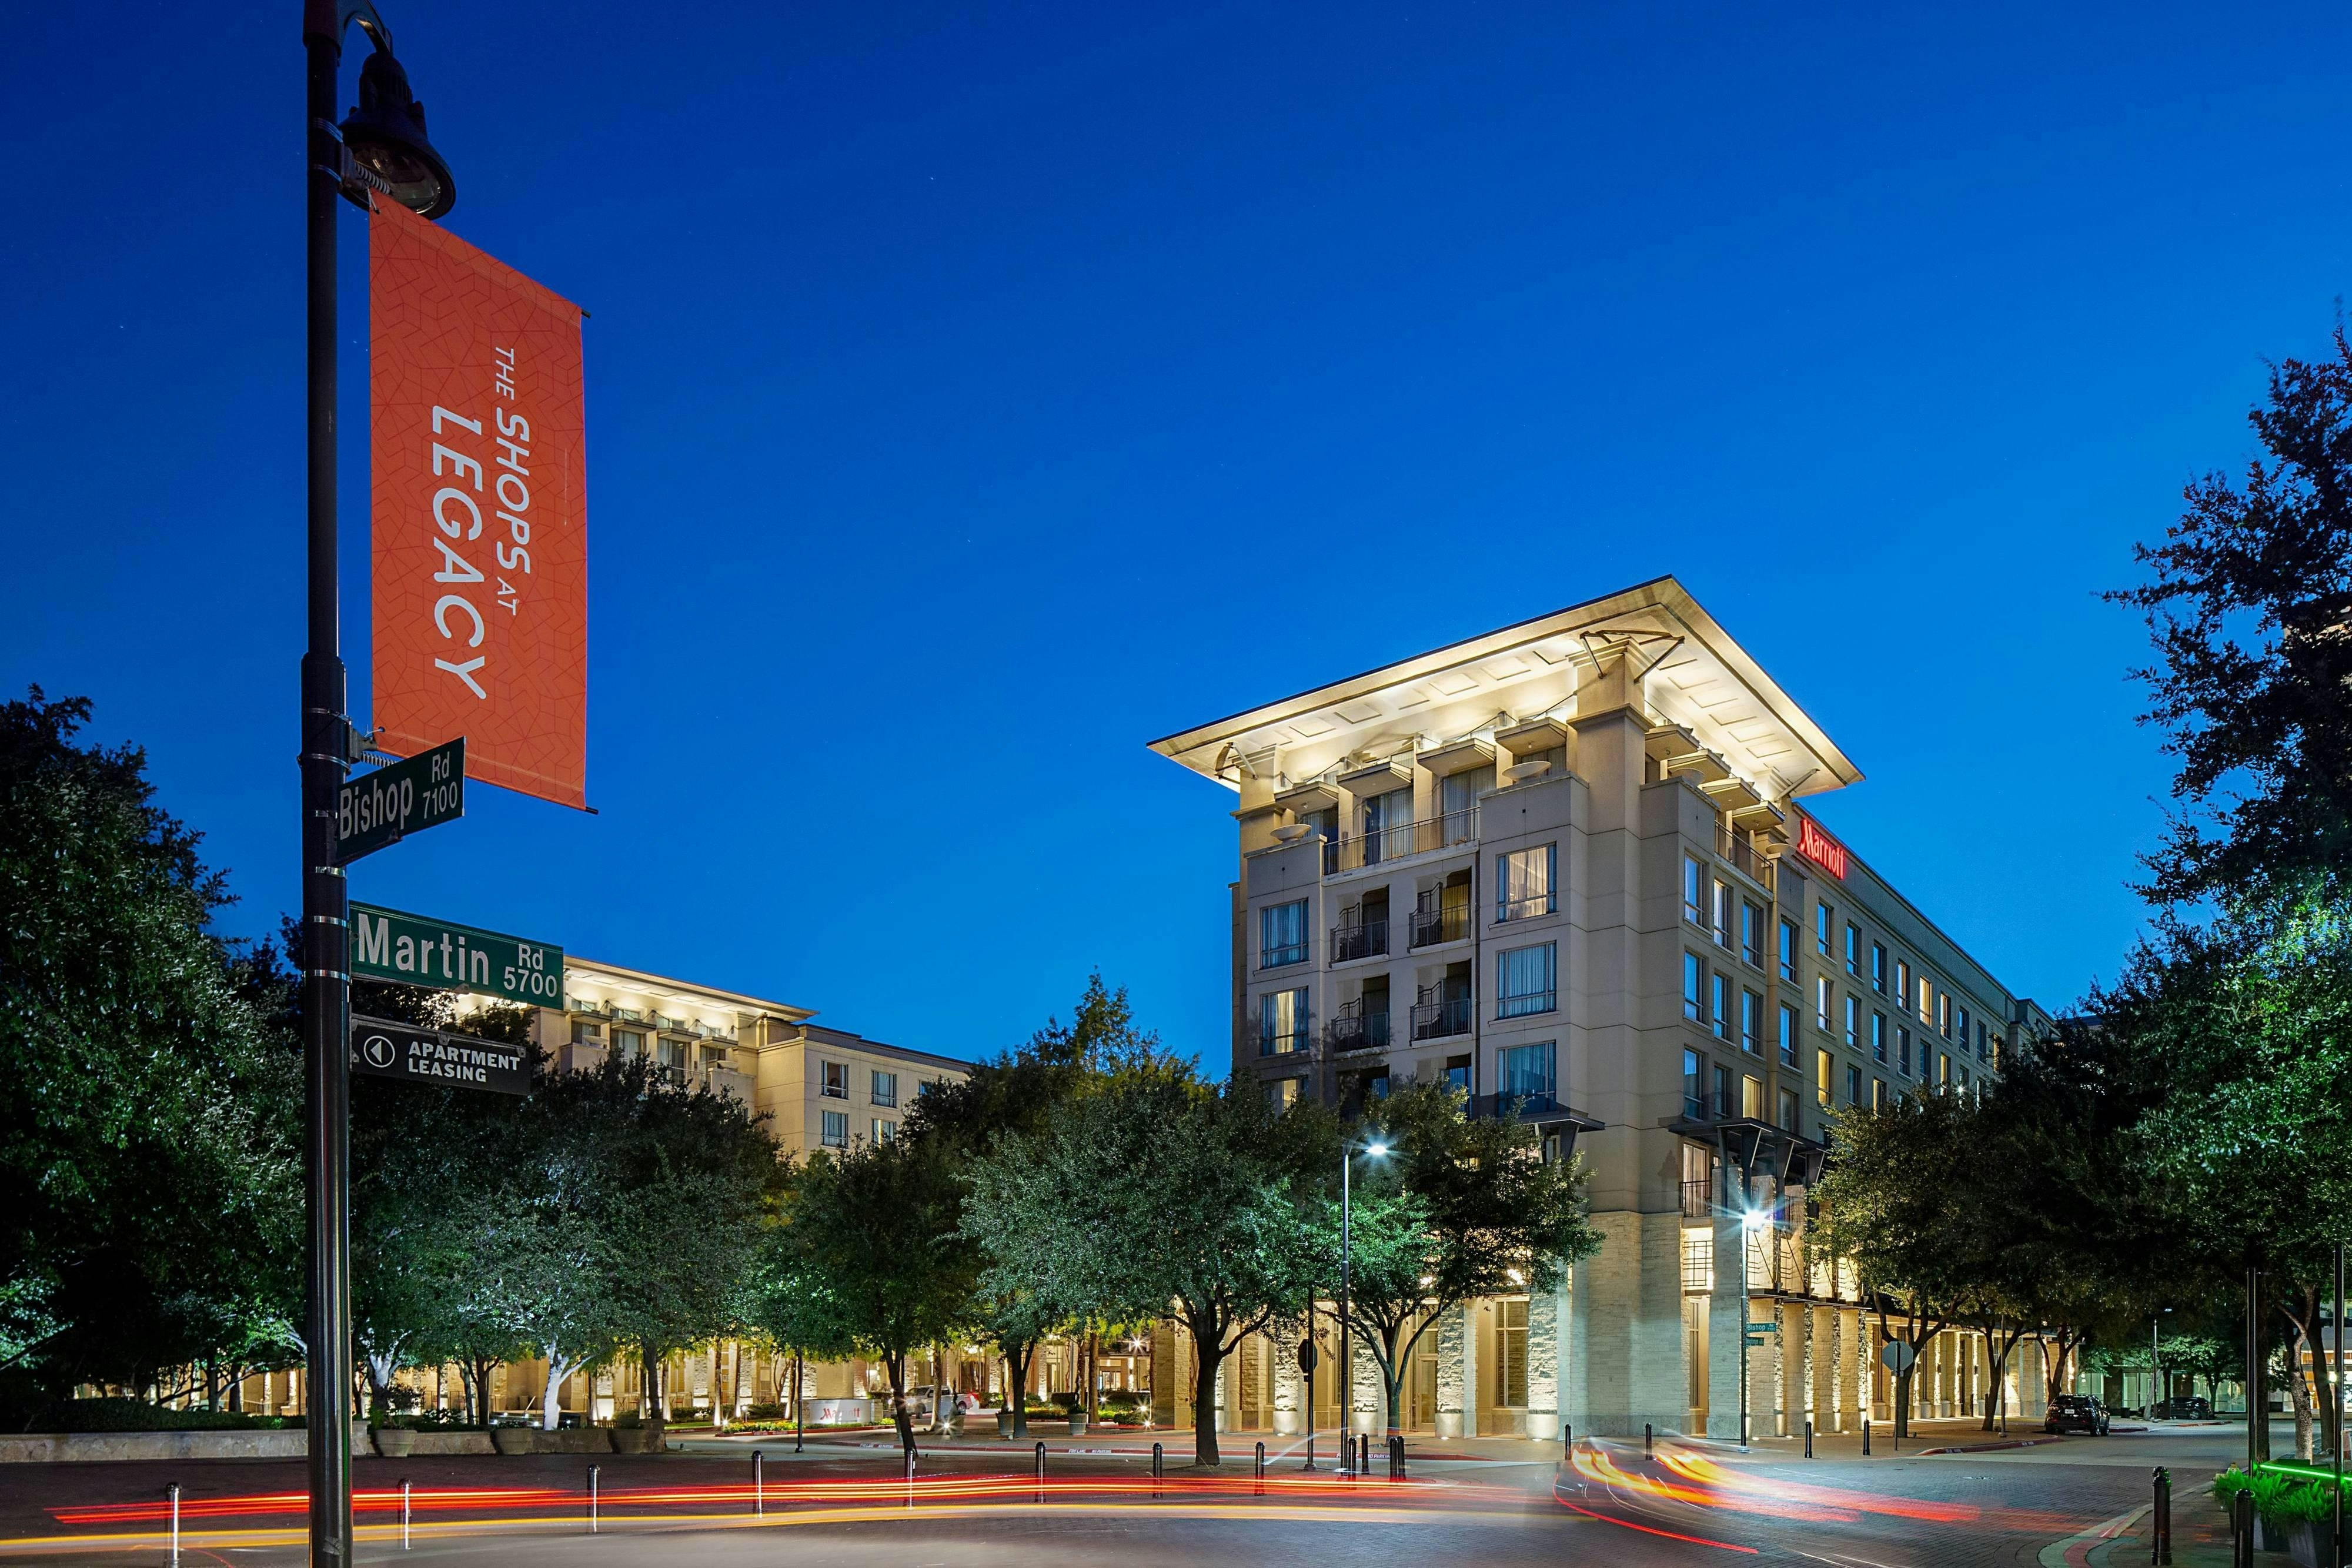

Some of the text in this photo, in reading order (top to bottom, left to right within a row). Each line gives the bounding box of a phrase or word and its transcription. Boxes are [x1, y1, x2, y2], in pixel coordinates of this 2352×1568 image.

[495, 347, 530, 616] THE SHOPS AT
[432, 405, 487, 700] LEGACY
[339, 751, 450, 840] Bishop Rd
[423, 781, 457, 819] 7100
[1797, 818, 1845, 880] Marriott
[358, 912, 543, 986] Martin Rd
[503, 964, 557, 998] 5700
[407, 1058, 487, 1083] LEASING
[408, 1041, 520, 1071] APARTMENT
